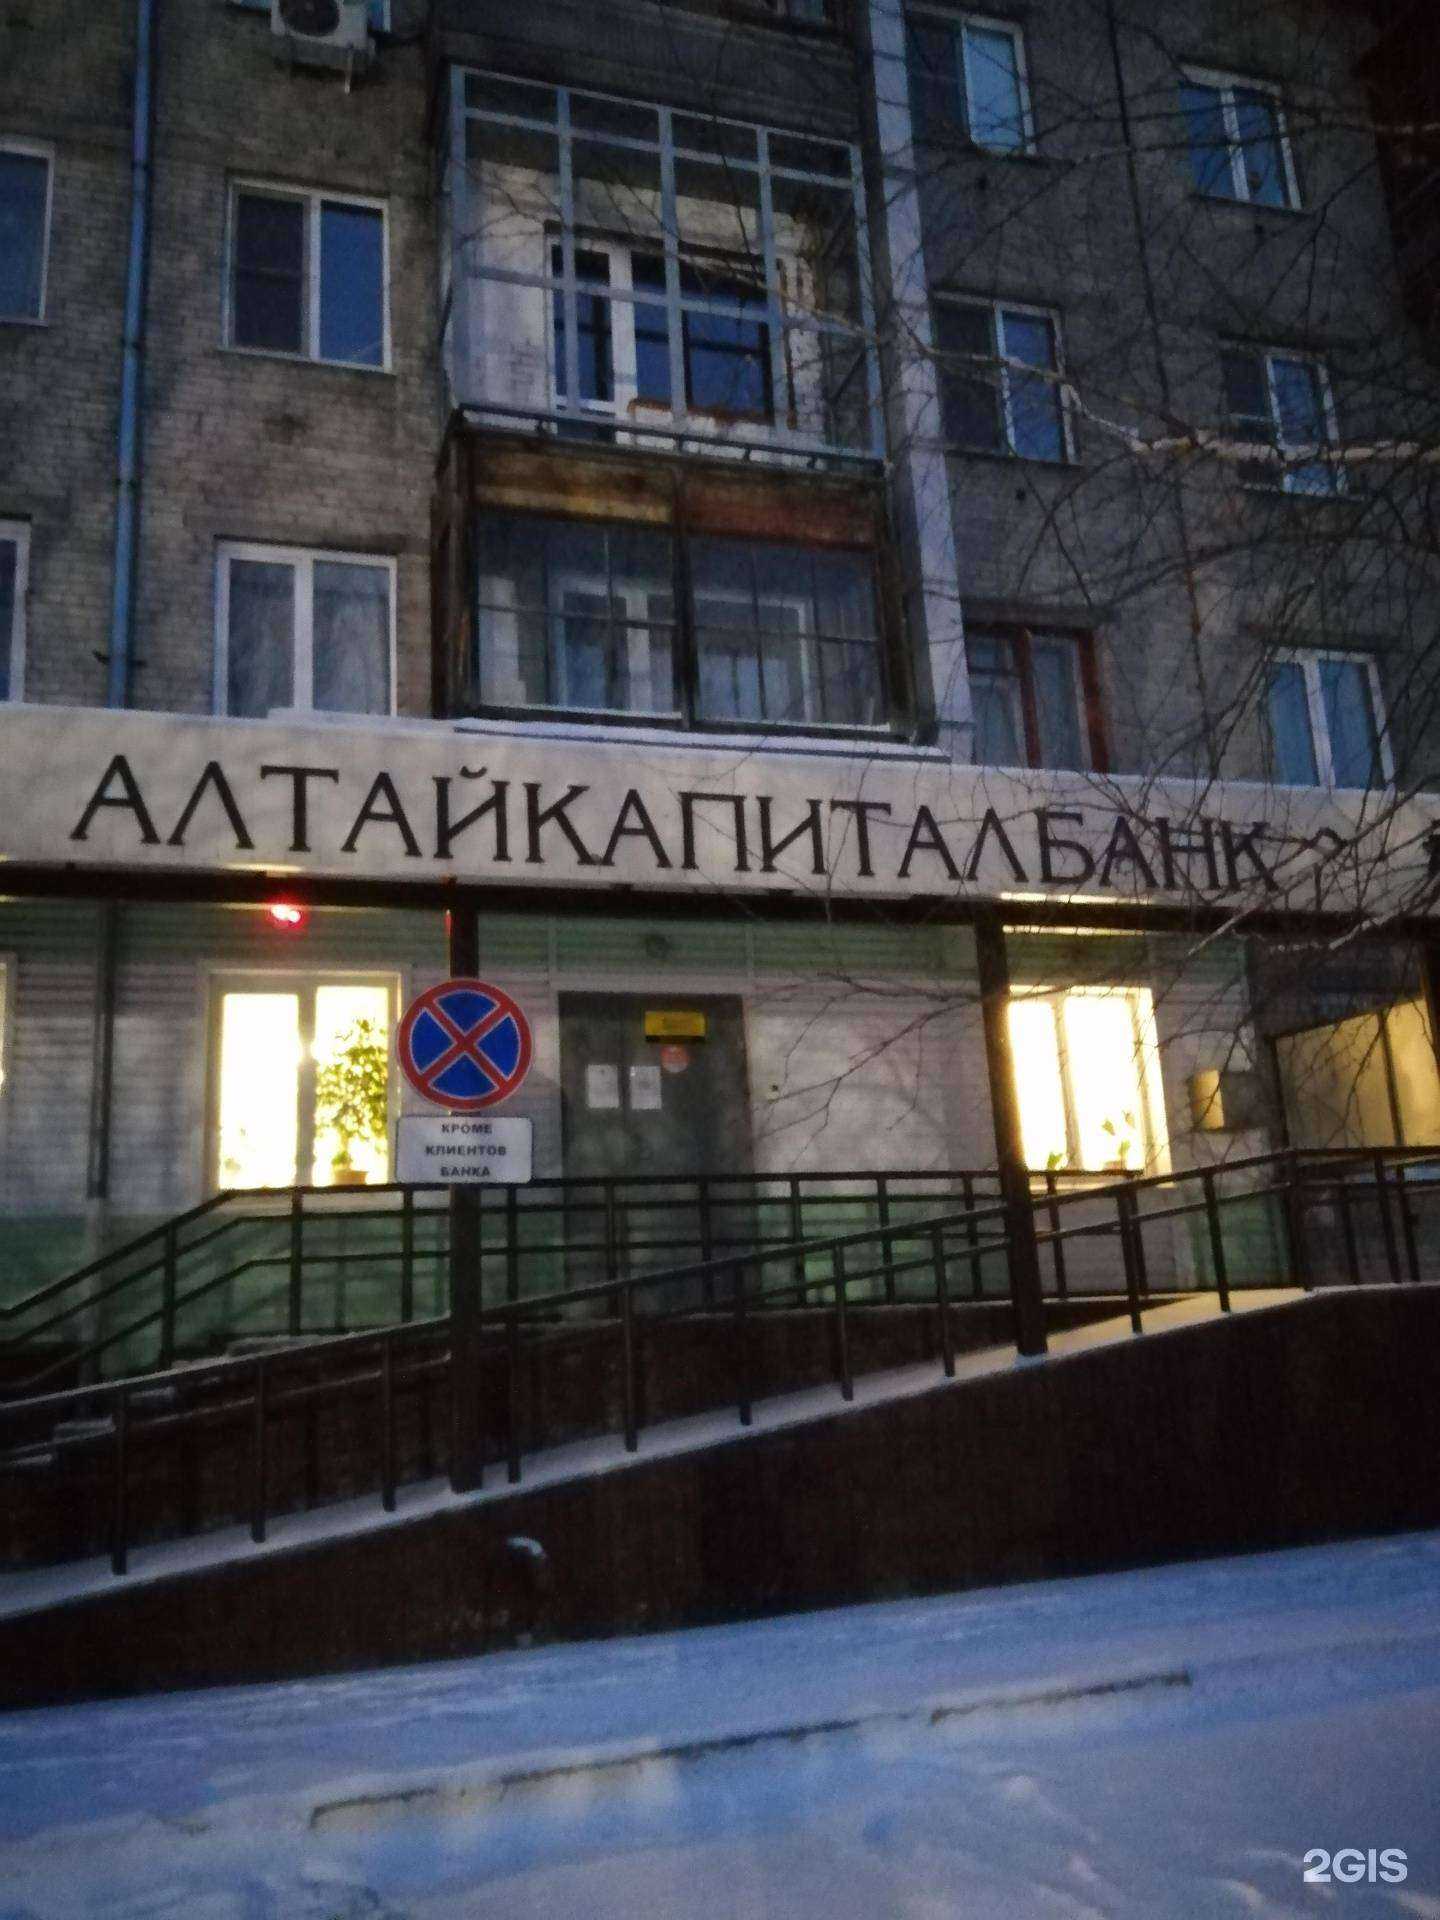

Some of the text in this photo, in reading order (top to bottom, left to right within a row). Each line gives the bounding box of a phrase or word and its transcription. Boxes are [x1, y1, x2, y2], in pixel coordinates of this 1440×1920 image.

[70, 755, 1281, 892] АЛТАЙКАПИТАЛБАНК
[441, 1124, 493, 1134] КРОМЕ
[425, 1145, 507, 1156] КЛИЕНТОВ
[441, 1166, 490, 1177] БАНКА
